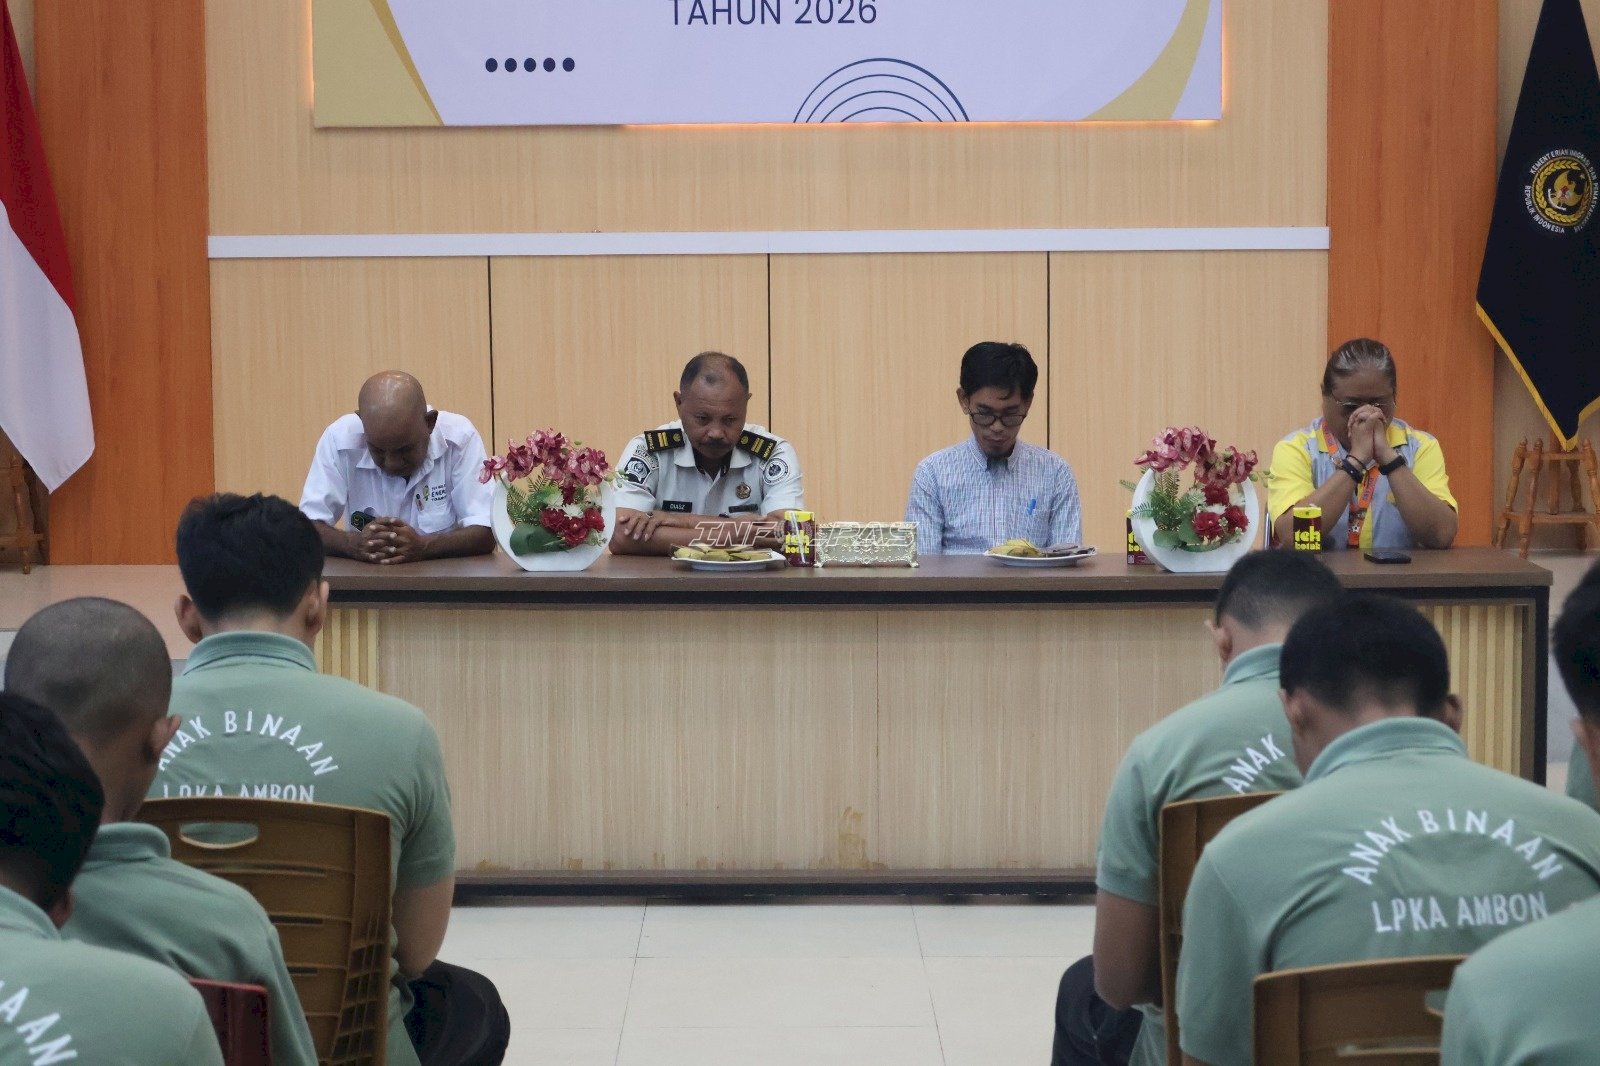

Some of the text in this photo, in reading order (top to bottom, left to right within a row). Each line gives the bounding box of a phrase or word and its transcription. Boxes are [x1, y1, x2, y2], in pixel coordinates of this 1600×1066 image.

[668, 0, 877, 25] TAHUN 2026
[1524, 185, 1565, 234] REPUBLIK INDONESIA
[1295, 525, 1321, 542] teh
[225, 711, 339, 776] BINAAN
[1222, 733, 1285, 796] ANAK
[1342, 809, 1563, 885] ANAK BINAAN
[1372, 891, 1549, 932] LPKA AMBON
[0, 980, 78, 1066] AAN
